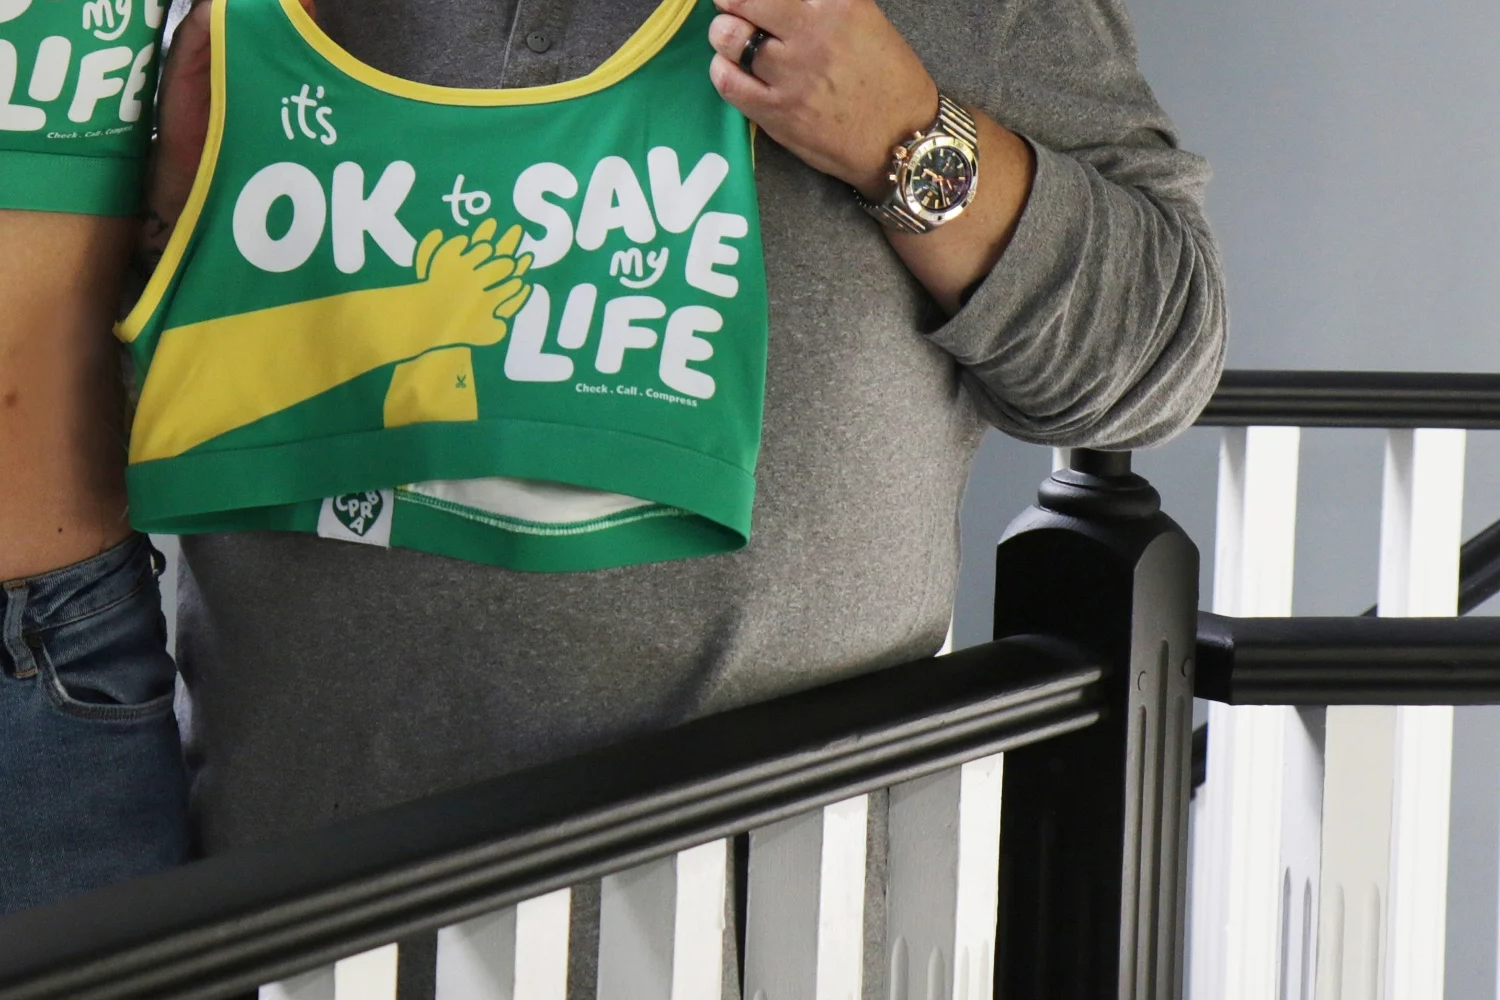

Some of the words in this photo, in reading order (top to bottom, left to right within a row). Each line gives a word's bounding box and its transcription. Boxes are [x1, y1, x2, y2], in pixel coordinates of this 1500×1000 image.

[280, 84, 338, 146] it's
[232, 160, 418, 274] OK
[441, 174, 492, 227] to
[511, 146, 749, 299] SAVE
[609, 246, 668, 289] my
[503, 283, 724, 400] LIFE
[575, 383, 608, 394] Check
[616, 385, 638, 396] Call
[645, 388, 698, 407] Compress
